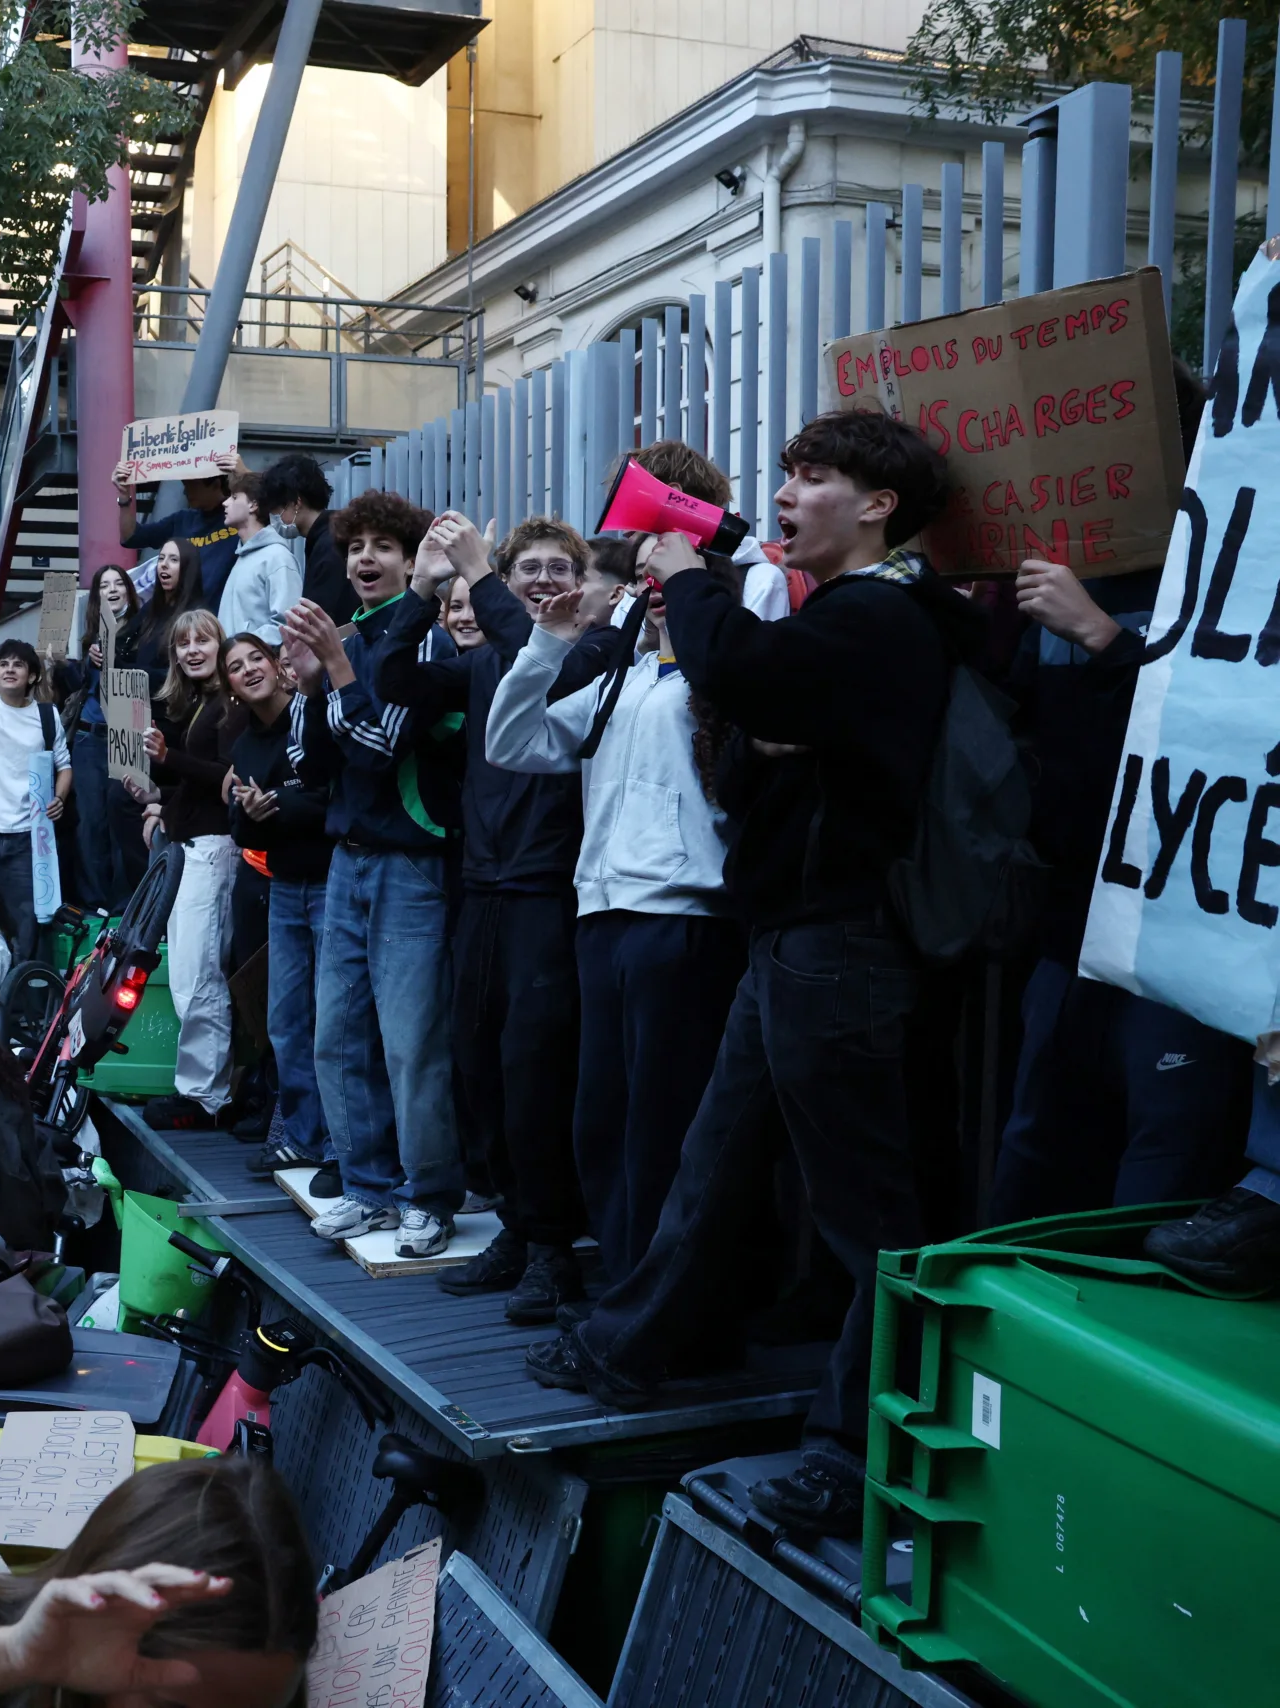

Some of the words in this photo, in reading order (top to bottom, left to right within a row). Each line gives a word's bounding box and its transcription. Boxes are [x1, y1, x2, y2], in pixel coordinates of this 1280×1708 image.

[836, 338, 959, 397] EMPLOIS
[972, 333, 1003, 365] DU
[1010, 298, 1131, 351] TEMPS
[956, 379, 1137, 454] CHARGES
[982, 463, 1134, 517] CASIER
[186, 526, 238, 548] WLESS
[87, 1416, 124, 1435] ON
[76, 1441, 120, 1465] EST
[30, 1465, 67, 1486] ON
[75, 1466, 118, 1489] PAS
[1055, 1564, 1064, 1574] L
[370, 1636, 401, 1679] UNE
